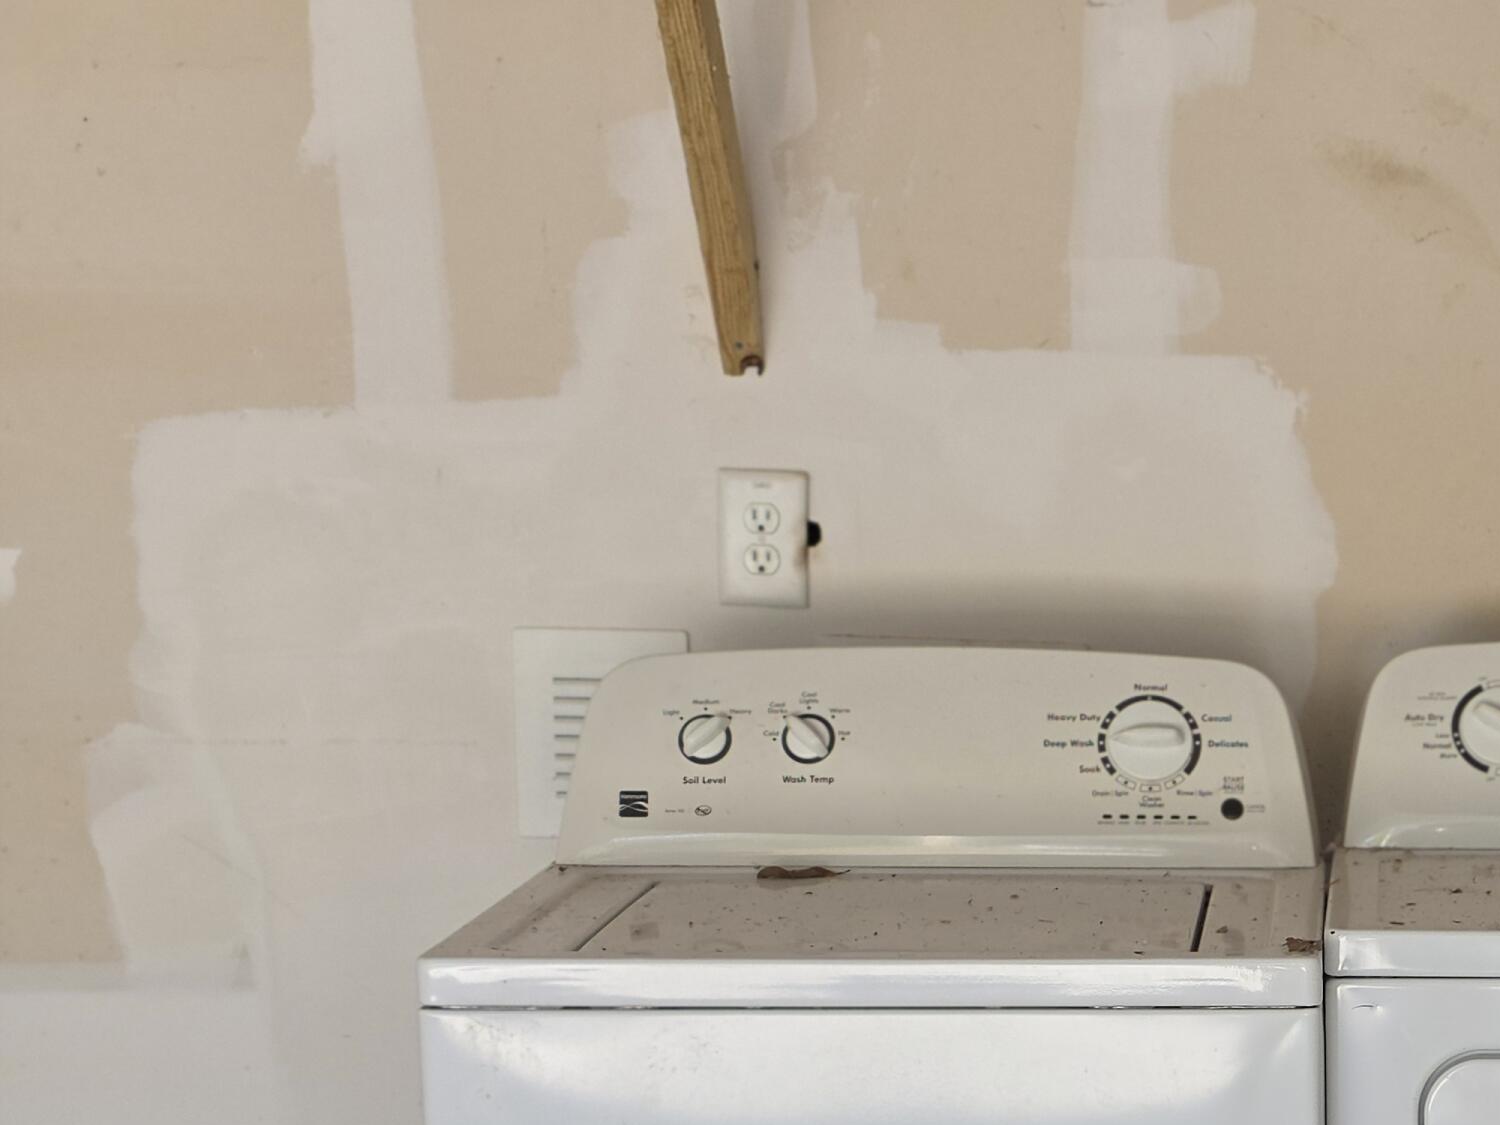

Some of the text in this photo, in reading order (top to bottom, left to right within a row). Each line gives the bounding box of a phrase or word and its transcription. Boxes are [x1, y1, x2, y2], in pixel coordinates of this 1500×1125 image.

[1047, 713, 1101, 722] Heavy Duty
[1201, 714, 1232, 722] Casual
[1043, 739, 1094, 748] Deep Wash
[1208, 740, 1249, 748] Delicates
[1079, 765, 1101, 773] Soak
[683, 776, 727, 785] Soil Level
[782, 775, 834, 785] Wash Temp
